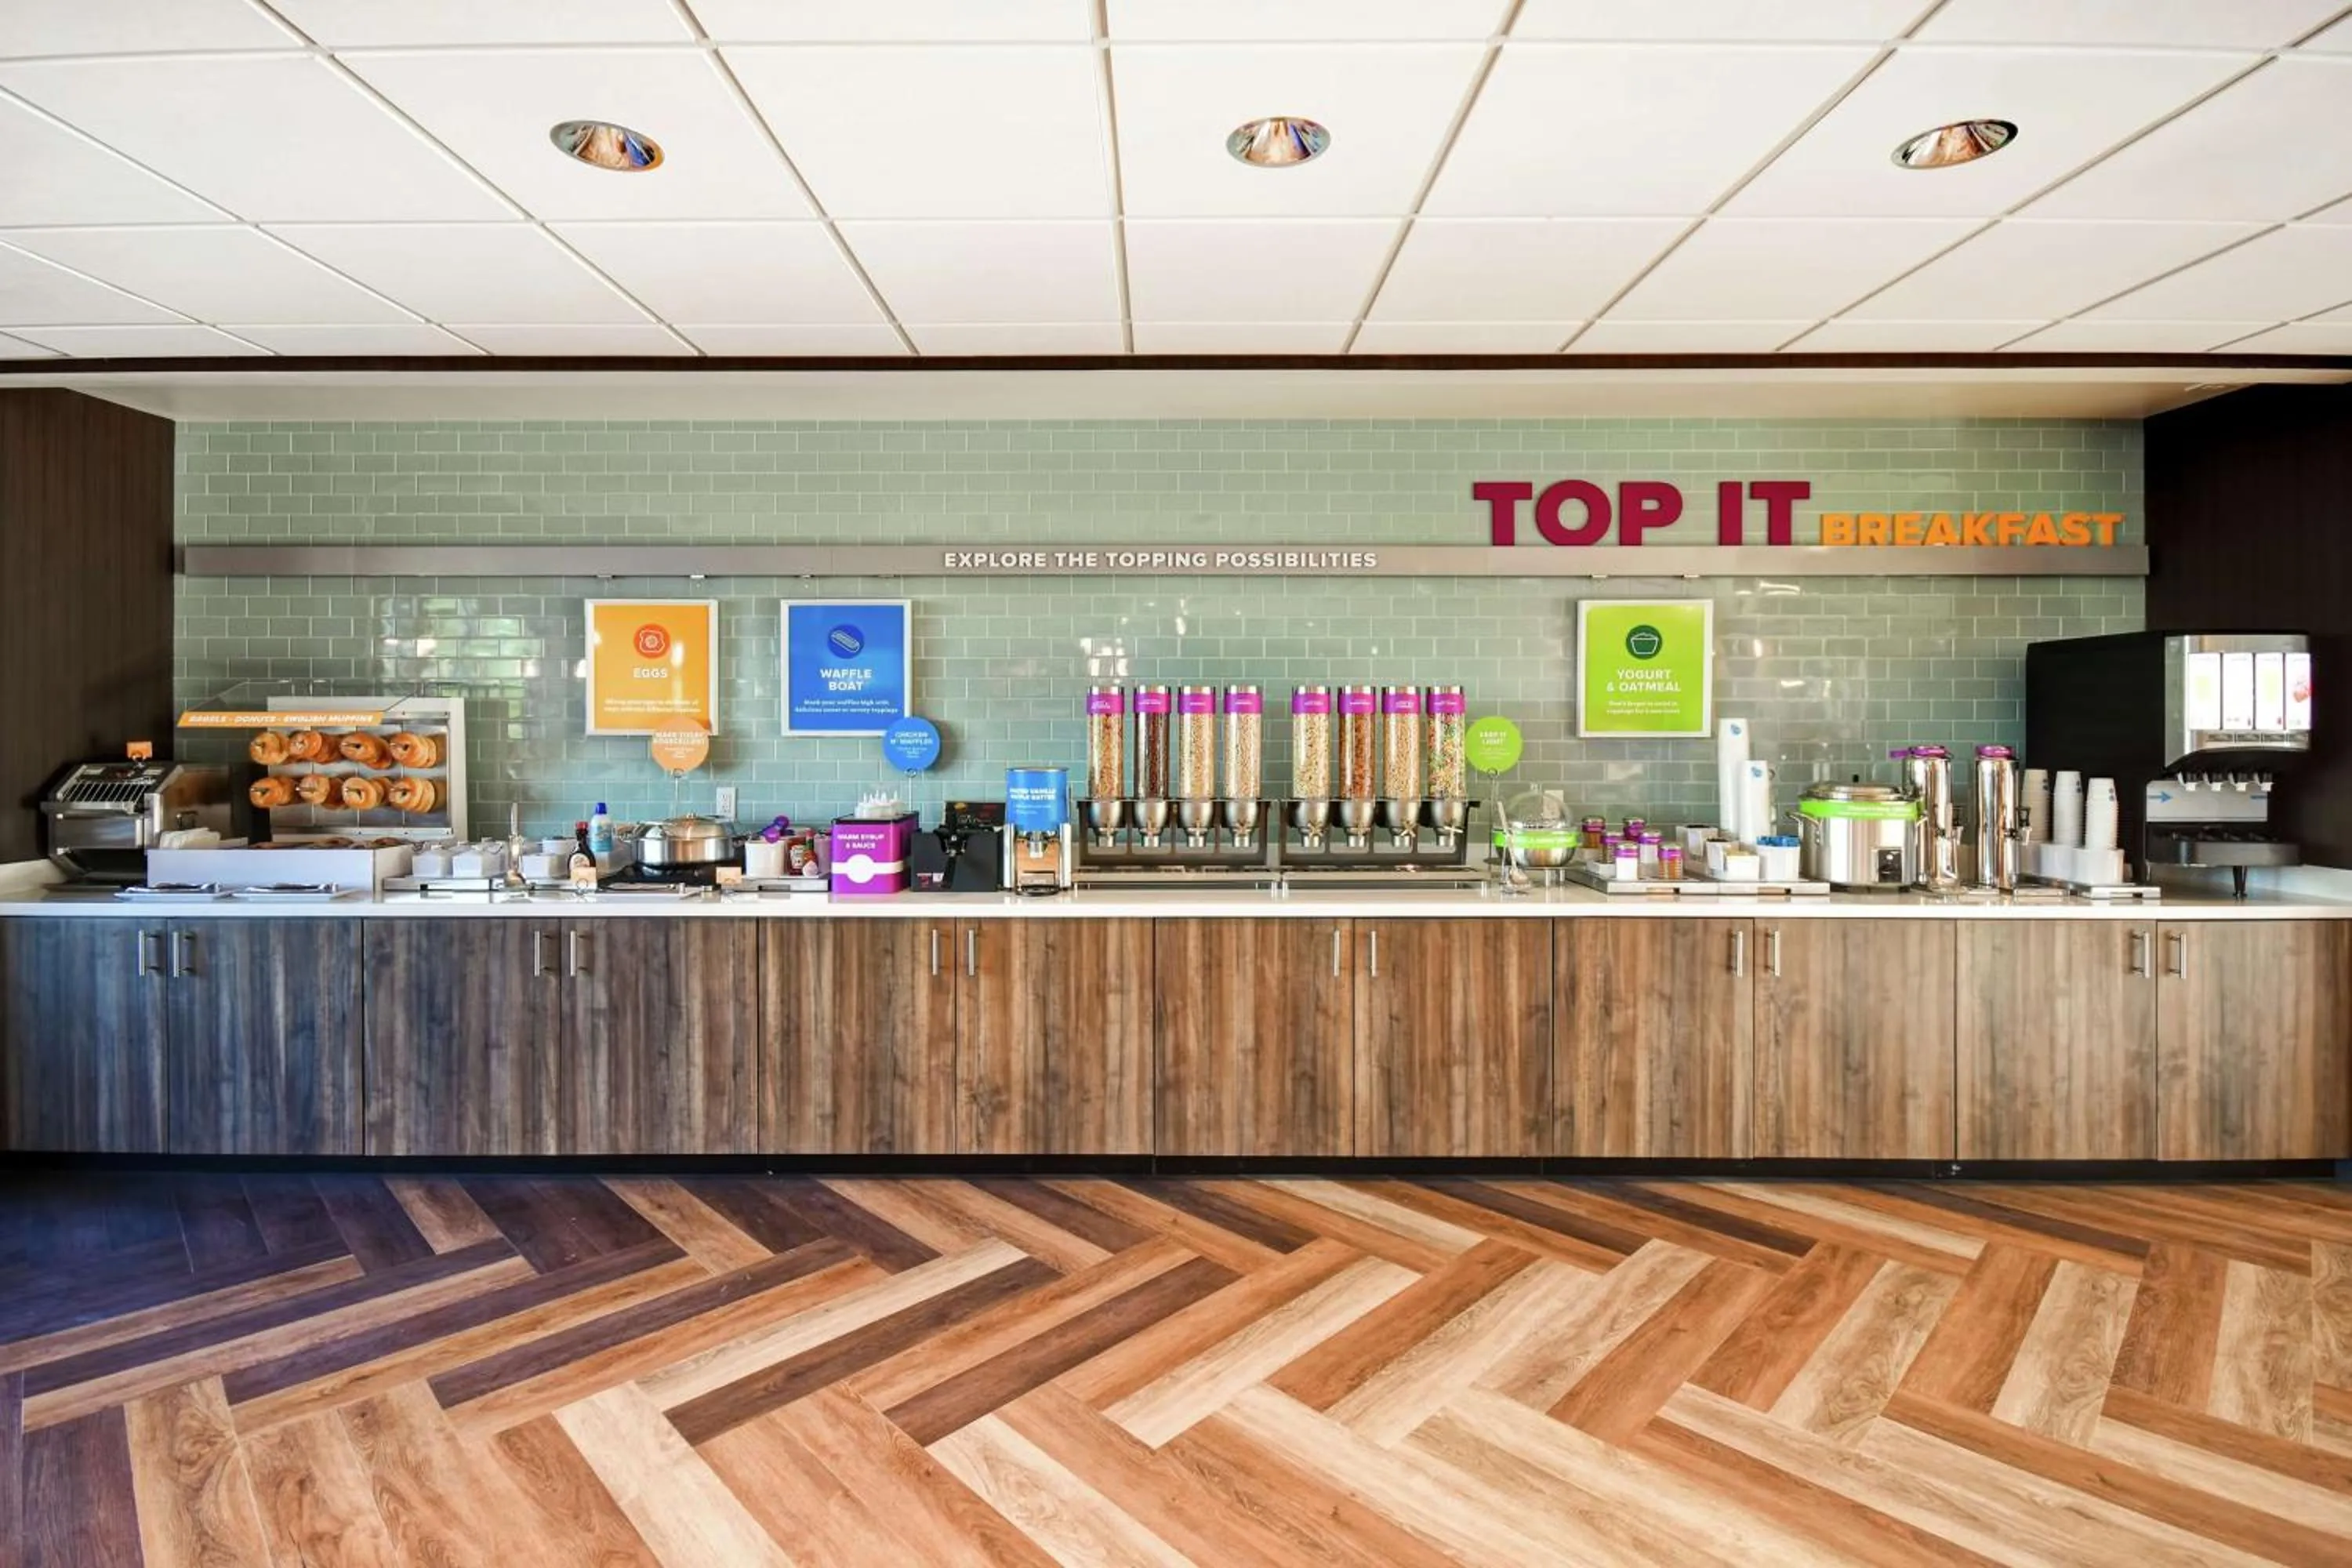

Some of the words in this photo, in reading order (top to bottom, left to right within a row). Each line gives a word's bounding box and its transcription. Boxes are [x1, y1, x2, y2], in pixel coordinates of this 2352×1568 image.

[1473, 480, 1683, 546] TOP
[1719, 481, 1811, 546] IT
[1820, 512, 2126, 546] BREAKFAST
[944, 552, 1047, 568] EXPLORE
[1055, 552, 1098, 568] THE
[1105, 552, 1207, 568] TOPPING
[1215, 552, 1377, 568] POSSIBILITIES
[633, 667, 668, 678] EGGS
[820, 669, 873, 678] WAFFLE
[1617, 669, 1671, 680] YOGURT
[829, 681, 864, 691] BOAT
[1606, 681, 1614, 691] &
[1619, 681, 1682, 691] OATMEAL
